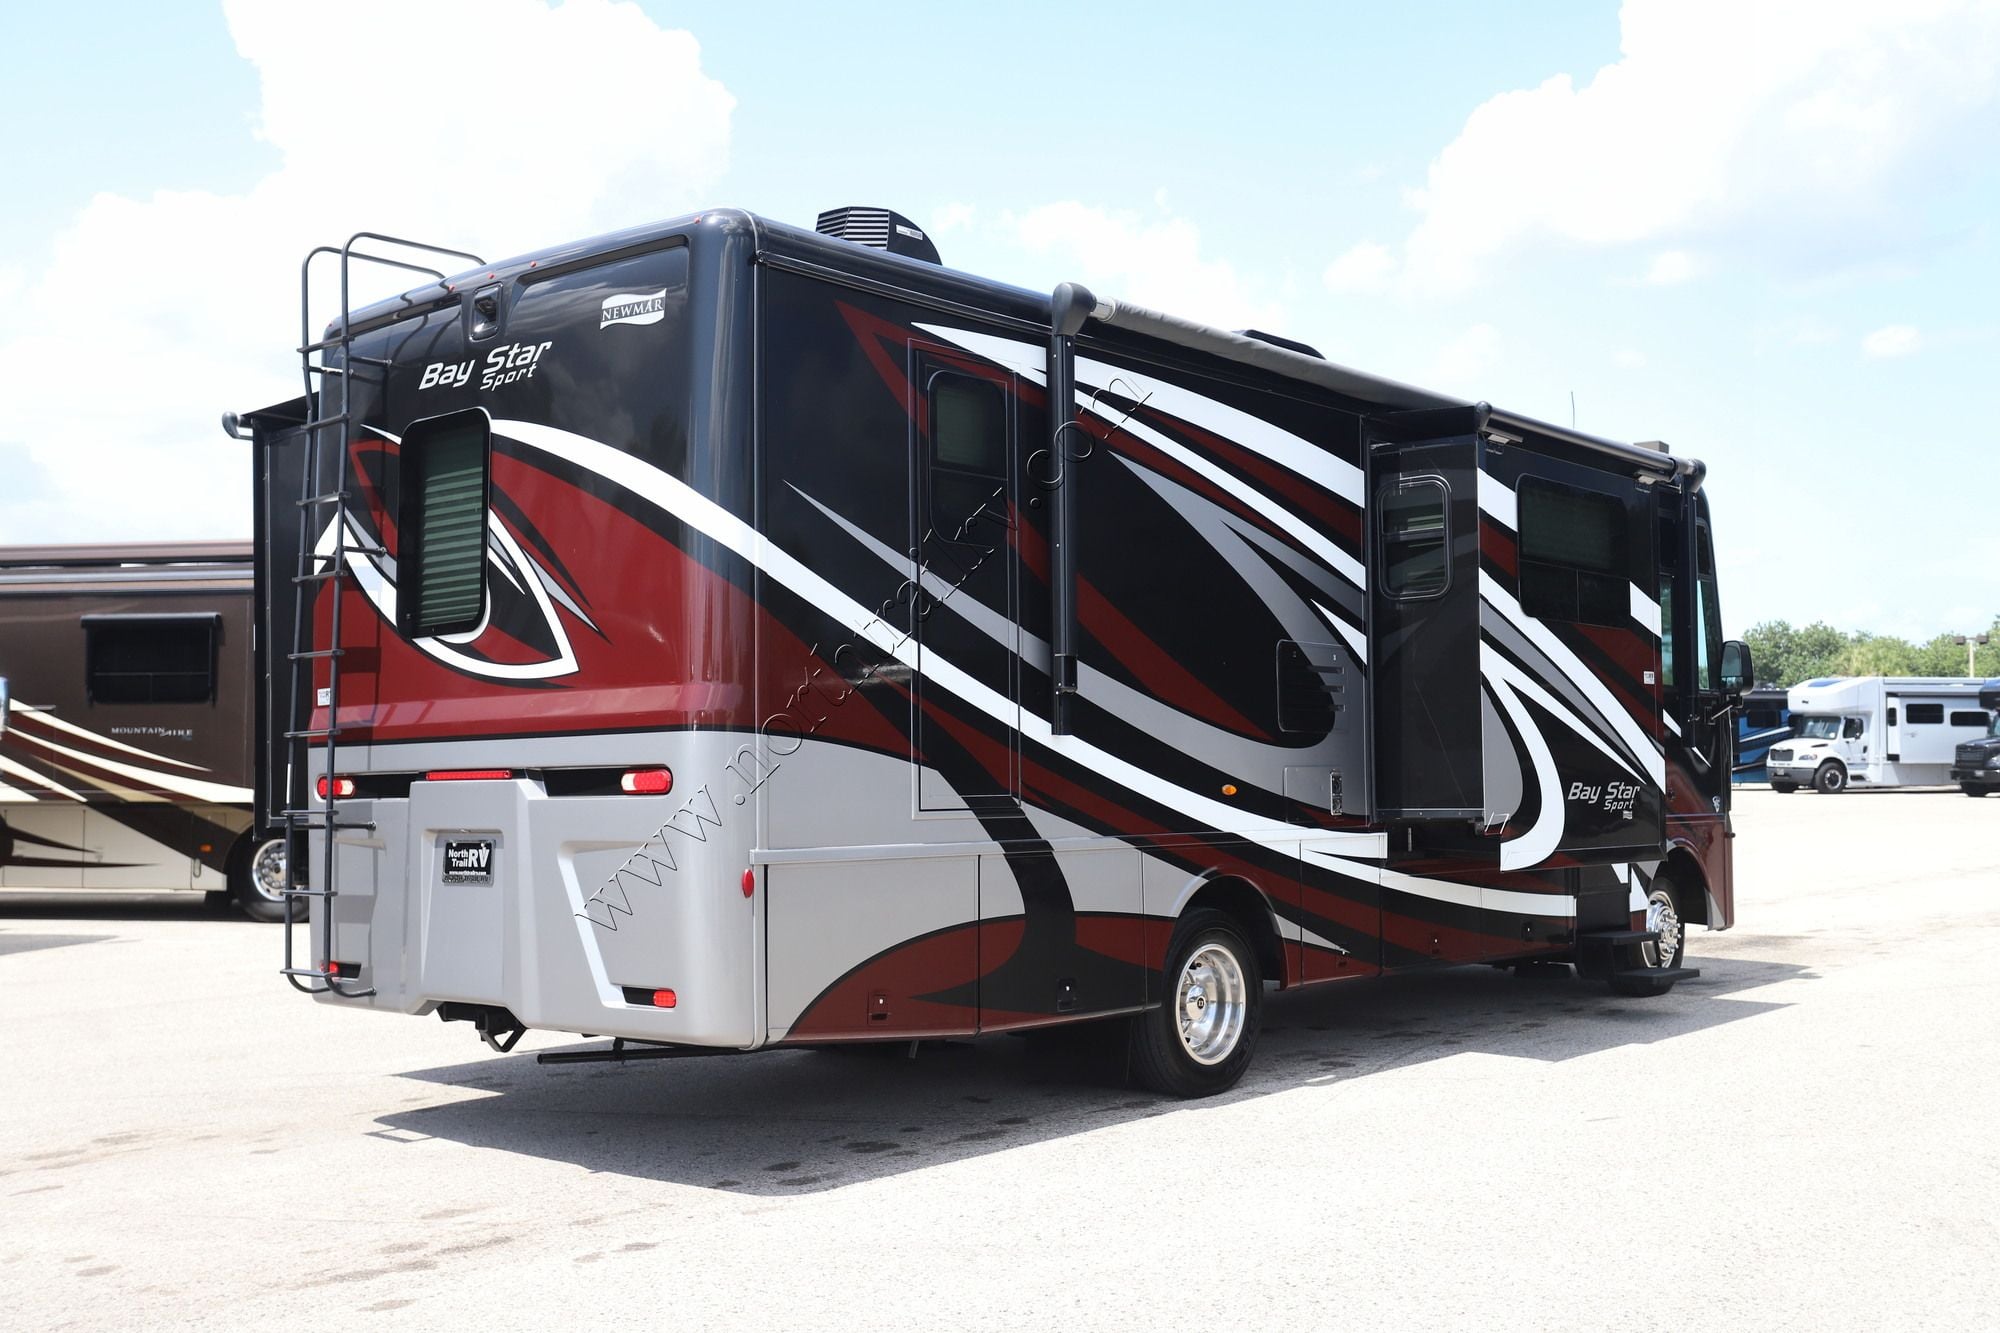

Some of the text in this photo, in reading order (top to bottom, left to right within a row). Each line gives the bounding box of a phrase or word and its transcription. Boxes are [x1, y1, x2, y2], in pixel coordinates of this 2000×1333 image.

[602, 299, 664, 321] NEWMAR
[419, 341, 552, 390] Bay Star
[480, 363, 537, 391] Sport
[1568, 782, 1640, 804] Bay Star
[1604, 799, 1633, 813] Sport
[449, 848, 468, 858] North
[452, 858, 468, 868] Trail
[468, 848, 490, 868] RV
